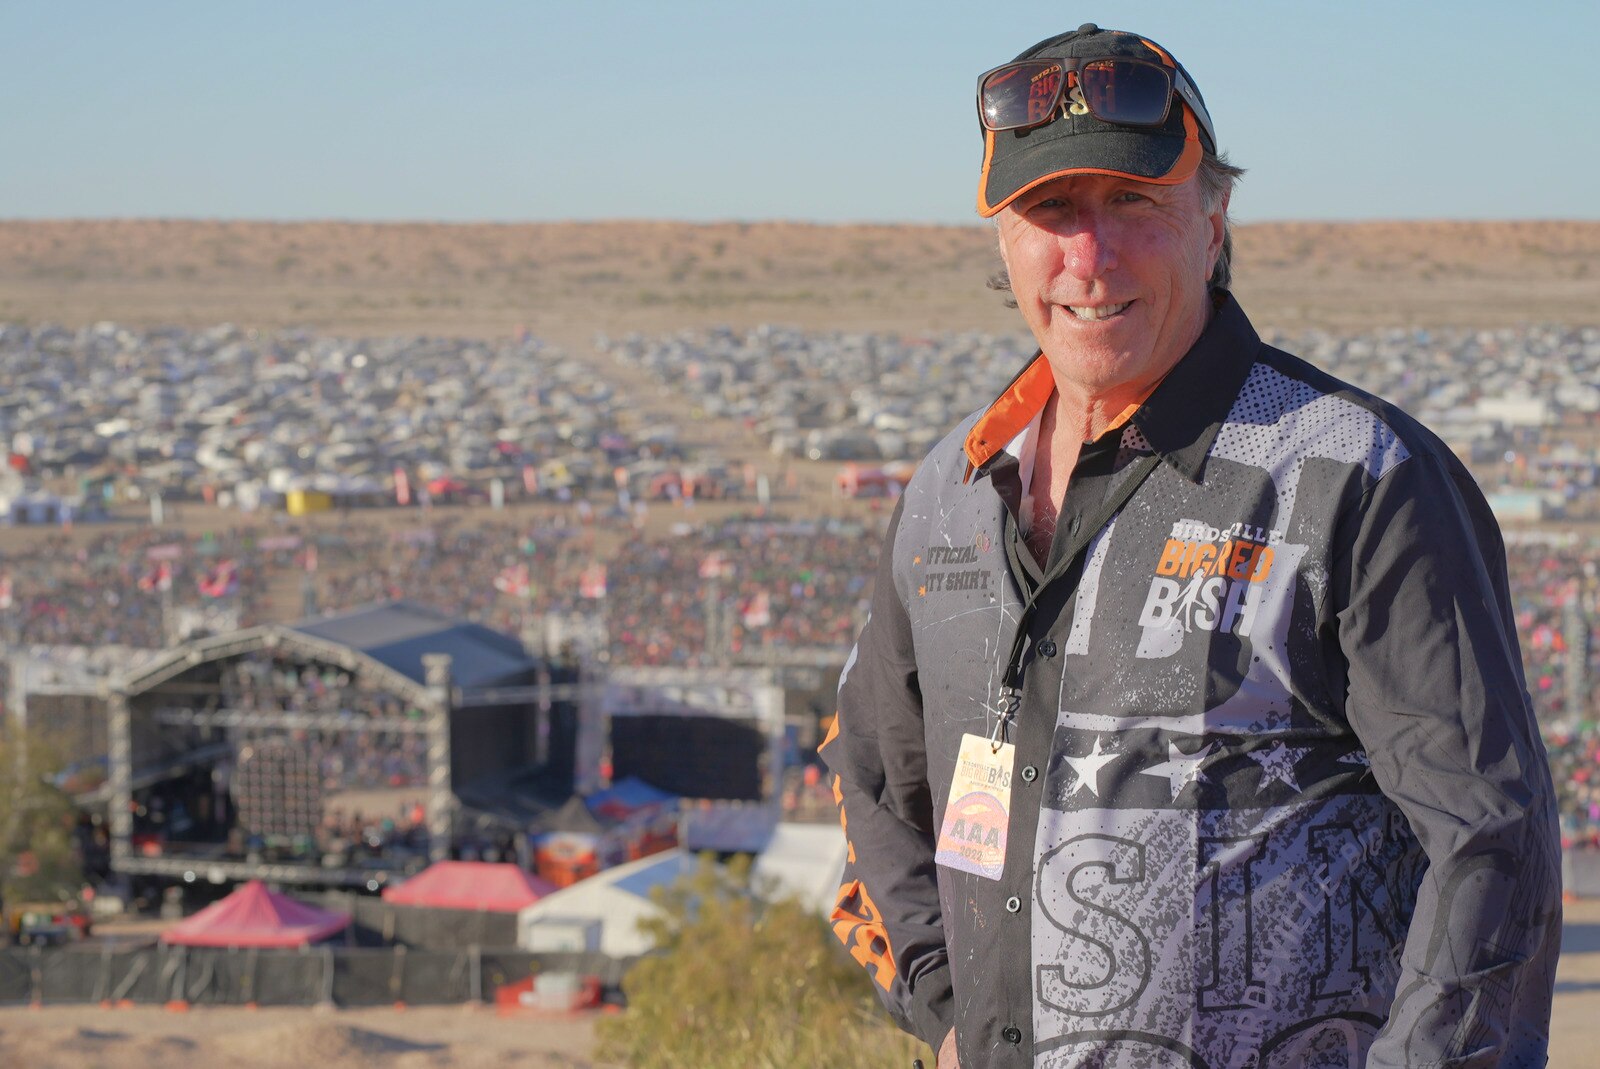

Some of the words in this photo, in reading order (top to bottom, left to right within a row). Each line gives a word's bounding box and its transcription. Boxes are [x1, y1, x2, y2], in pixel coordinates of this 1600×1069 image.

[926, 545, 979, 565] FFICIAL
[945, 570, 991, 592] SHIRT
[950, 818, 1000, 849] AAA
[960, 845, 983, 861] 2022
